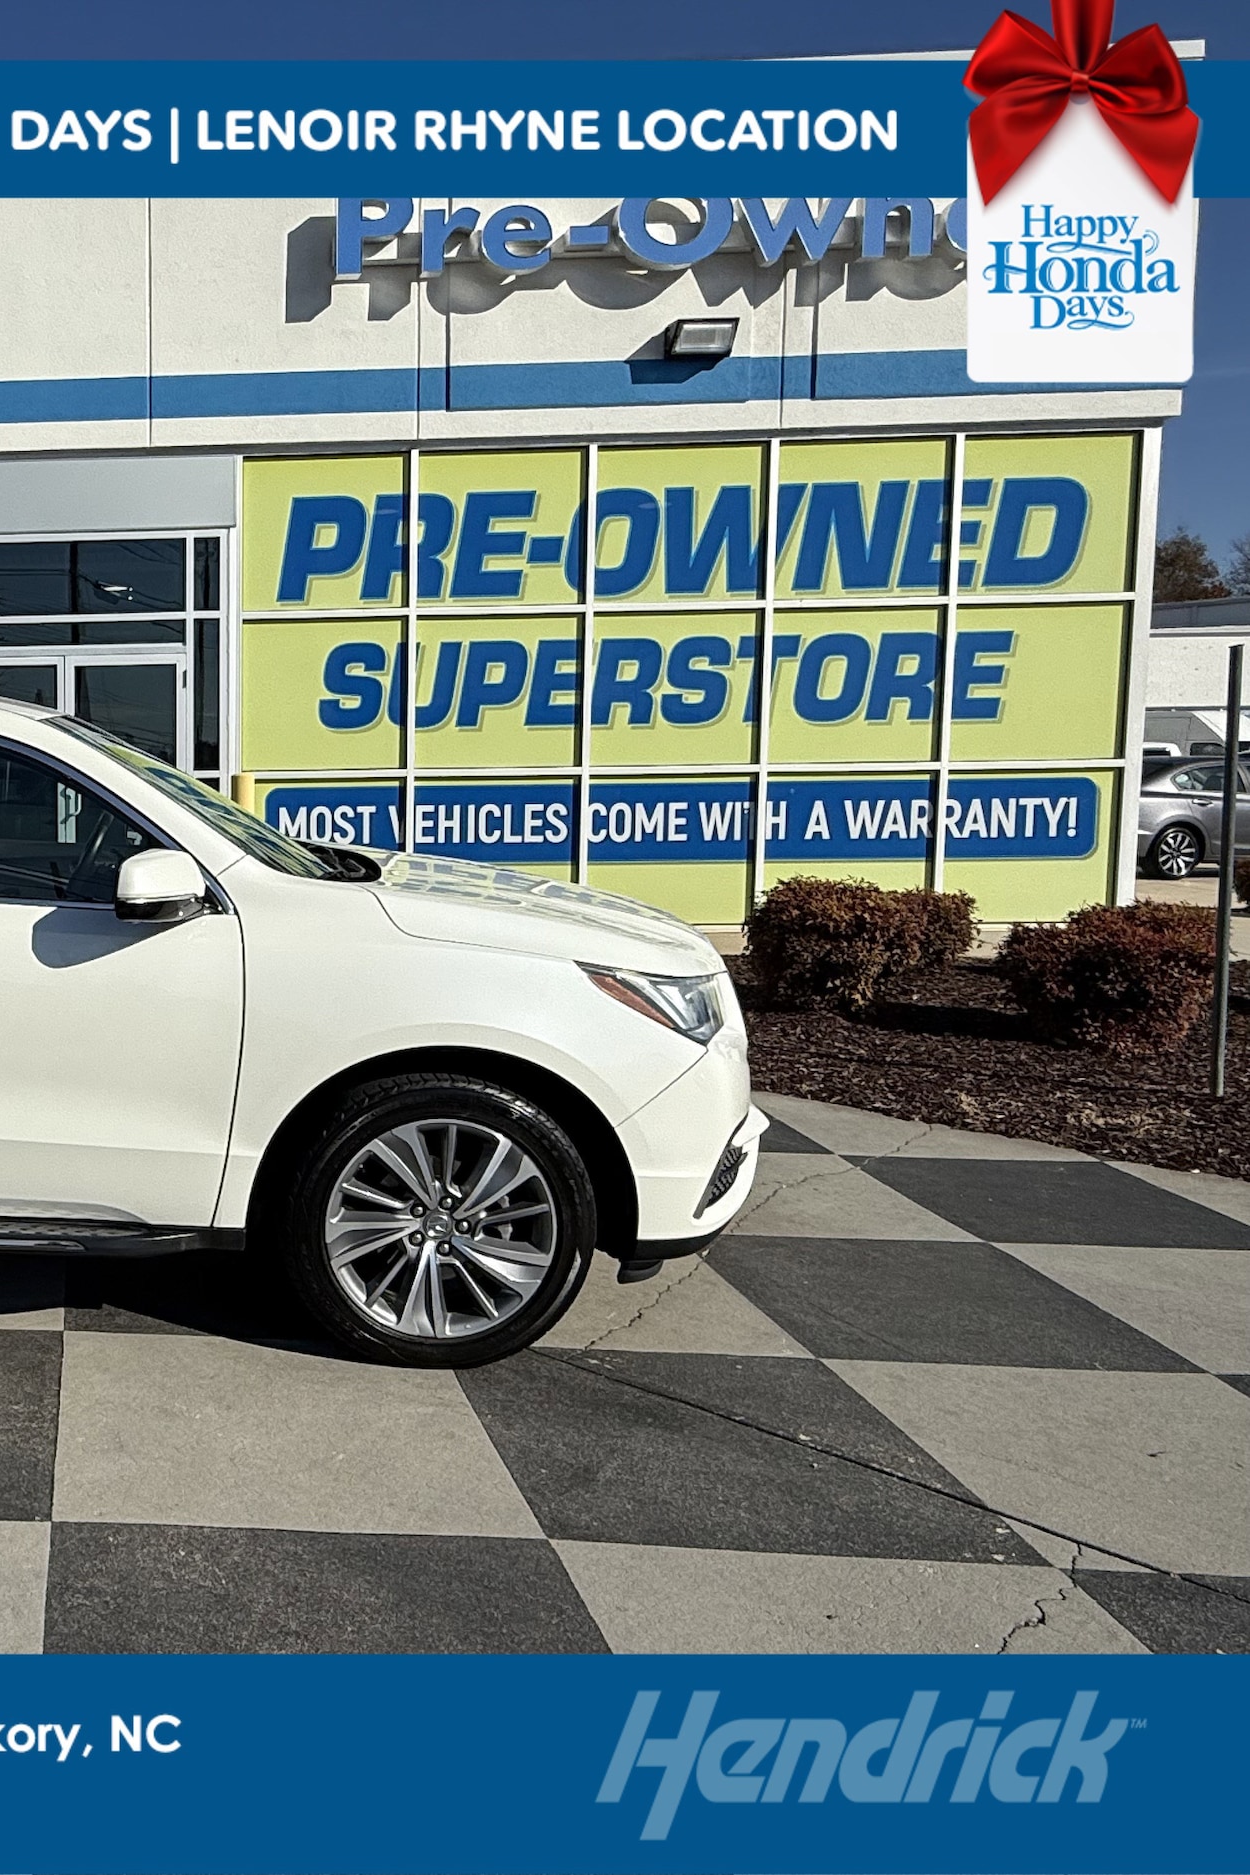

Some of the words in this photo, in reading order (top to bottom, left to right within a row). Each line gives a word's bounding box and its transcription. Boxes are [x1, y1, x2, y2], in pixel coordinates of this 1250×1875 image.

[335, 198, 967, 278] Pre-Own
[276, 477, 1090, 602] PRE-OWNED
[318, 630, 1015, 730] SUPERSTORE
[278, 805, 376, 844] MOST
[388, 803, 568, 844] VEHICLES
[587, 801, 687, 843] COME
[804, 800, 830, 840] A
[845, 797, 1078, 840] WARRANTY!
